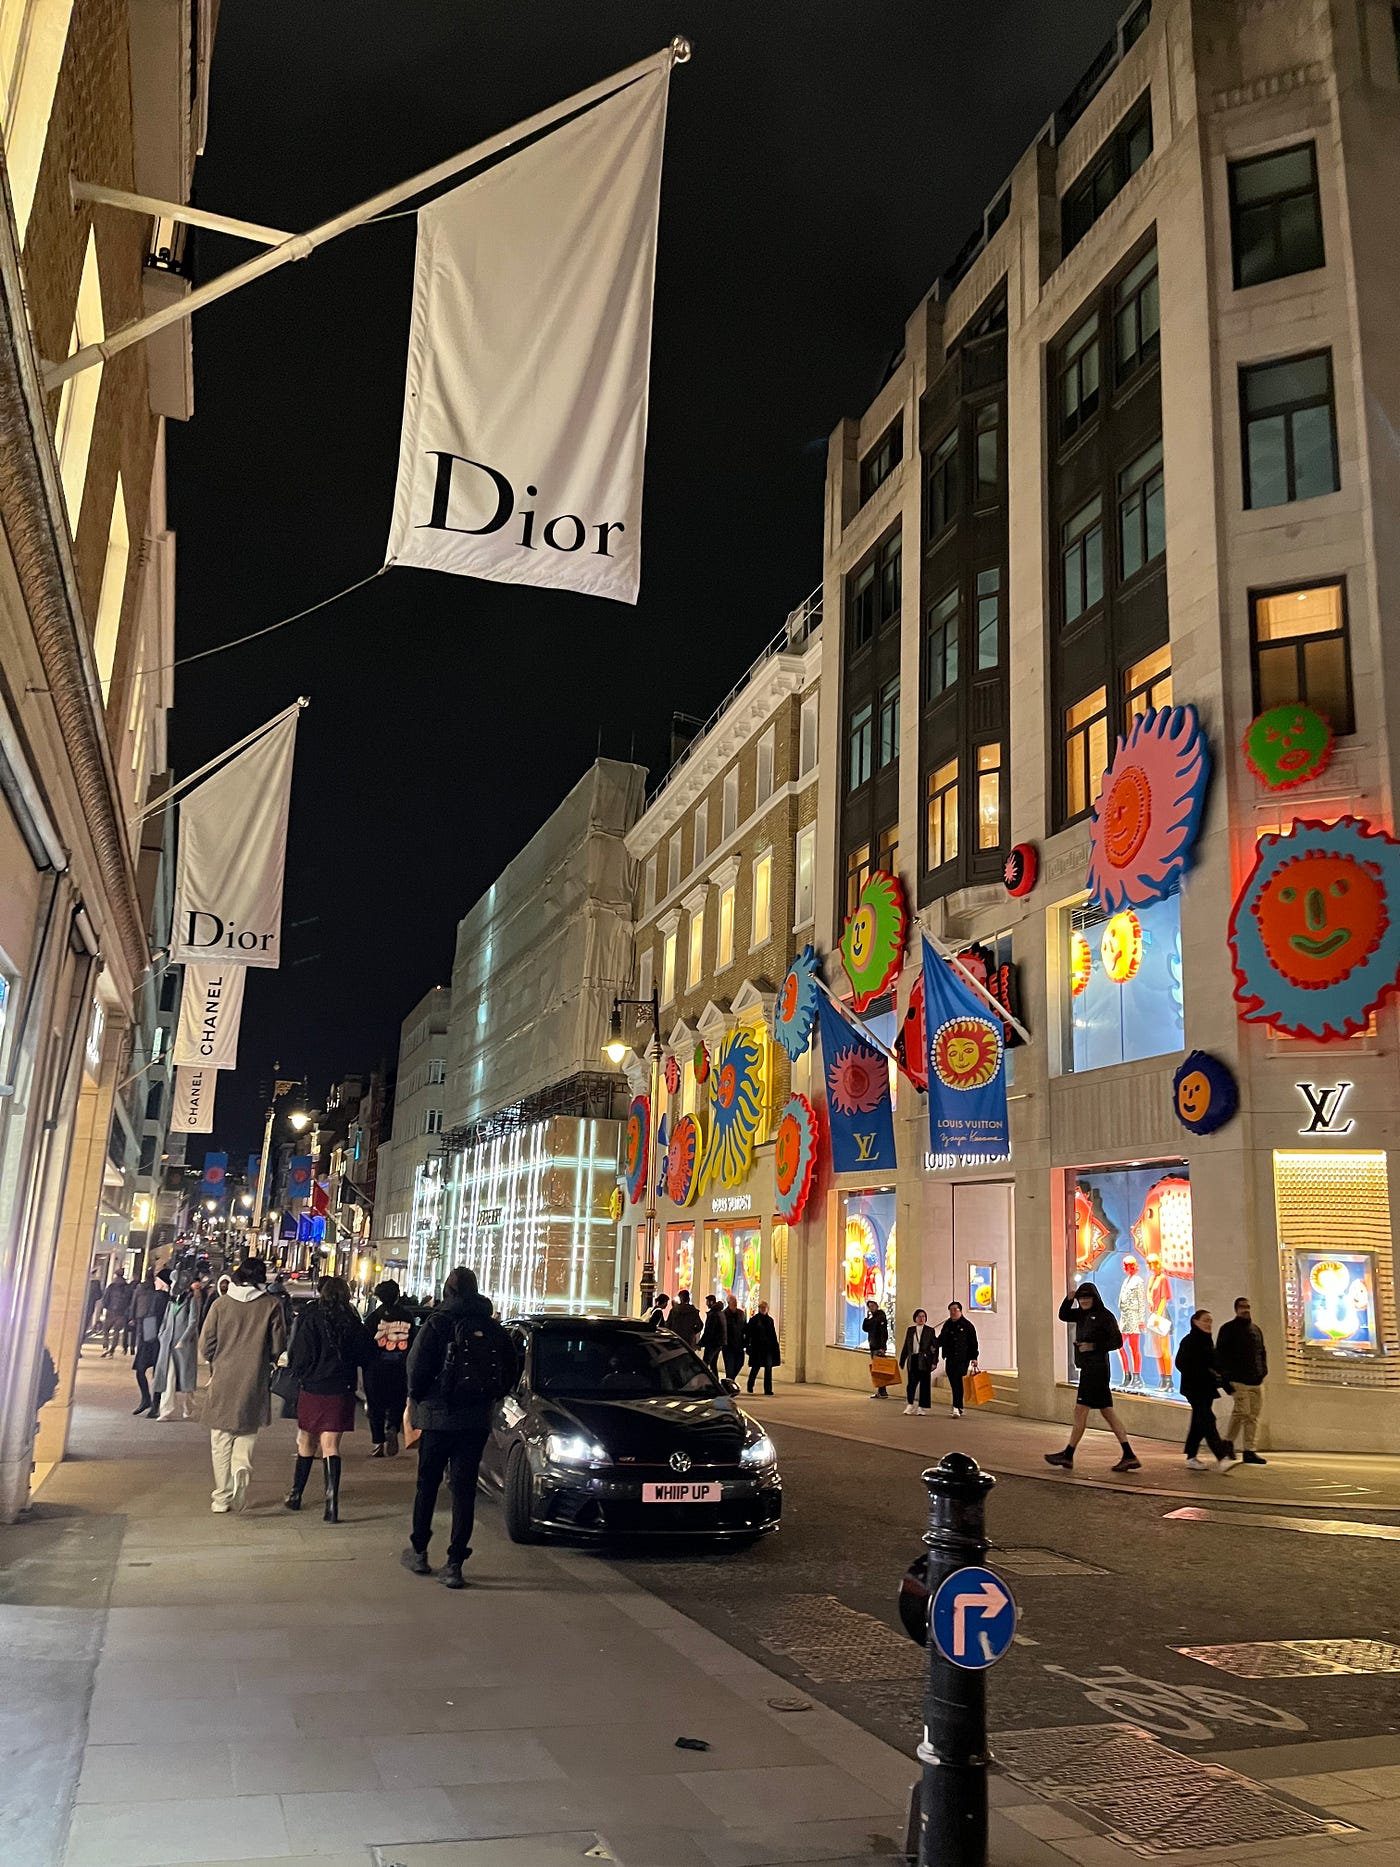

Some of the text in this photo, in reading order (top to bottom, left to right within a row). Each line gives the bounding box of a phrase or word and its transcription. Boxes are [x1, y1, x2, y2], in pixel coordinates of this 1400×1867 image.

[414, 450, 626, 558] Dior
[181, 910, 275, 951] Dior
[200, 976, 223, 1056] CHANEL
[188, 1071, 203, 1125] CHANEL
[937, 1119, 1003, 1129] LOUIS VUITTON
[692, 1485, 710, 1500] UP
